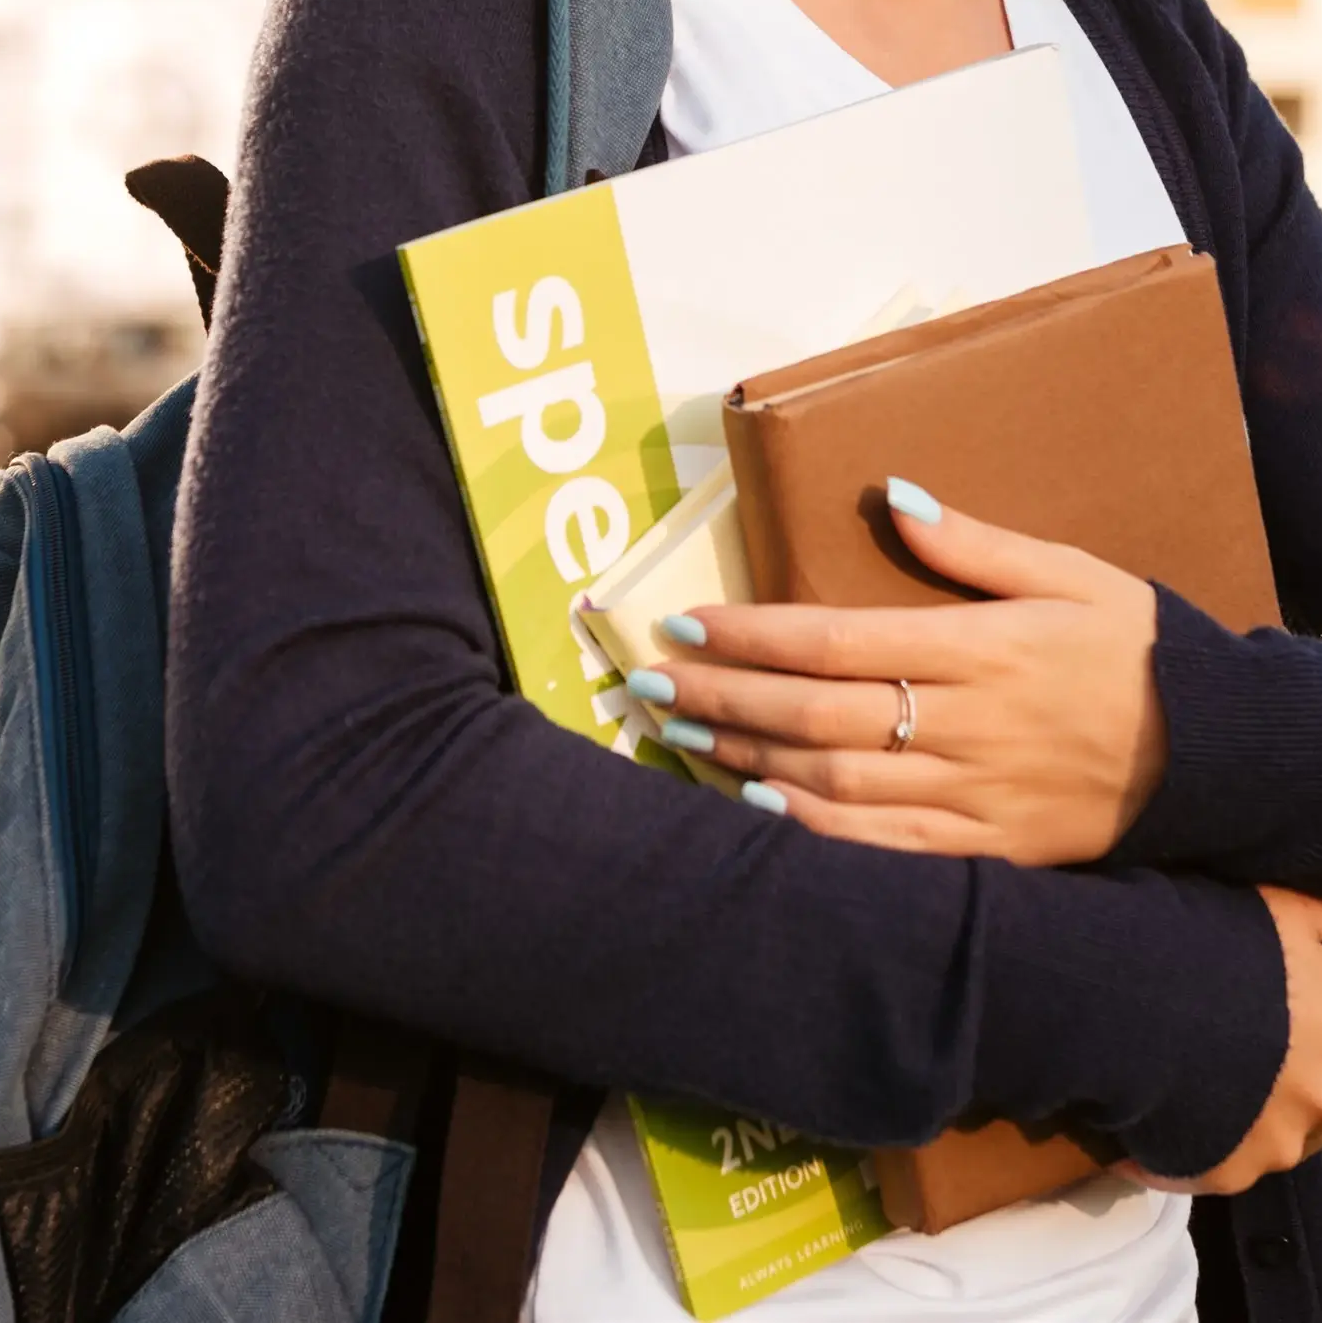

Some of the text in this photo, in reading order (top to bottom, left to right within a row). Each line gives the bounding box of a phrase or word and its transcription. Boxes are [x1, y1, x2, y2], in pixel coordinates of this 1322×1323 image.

[729, 1155, 822, 1220] EDITION
[739, 1220, 863, 1291] ALWAYS LEARNING
